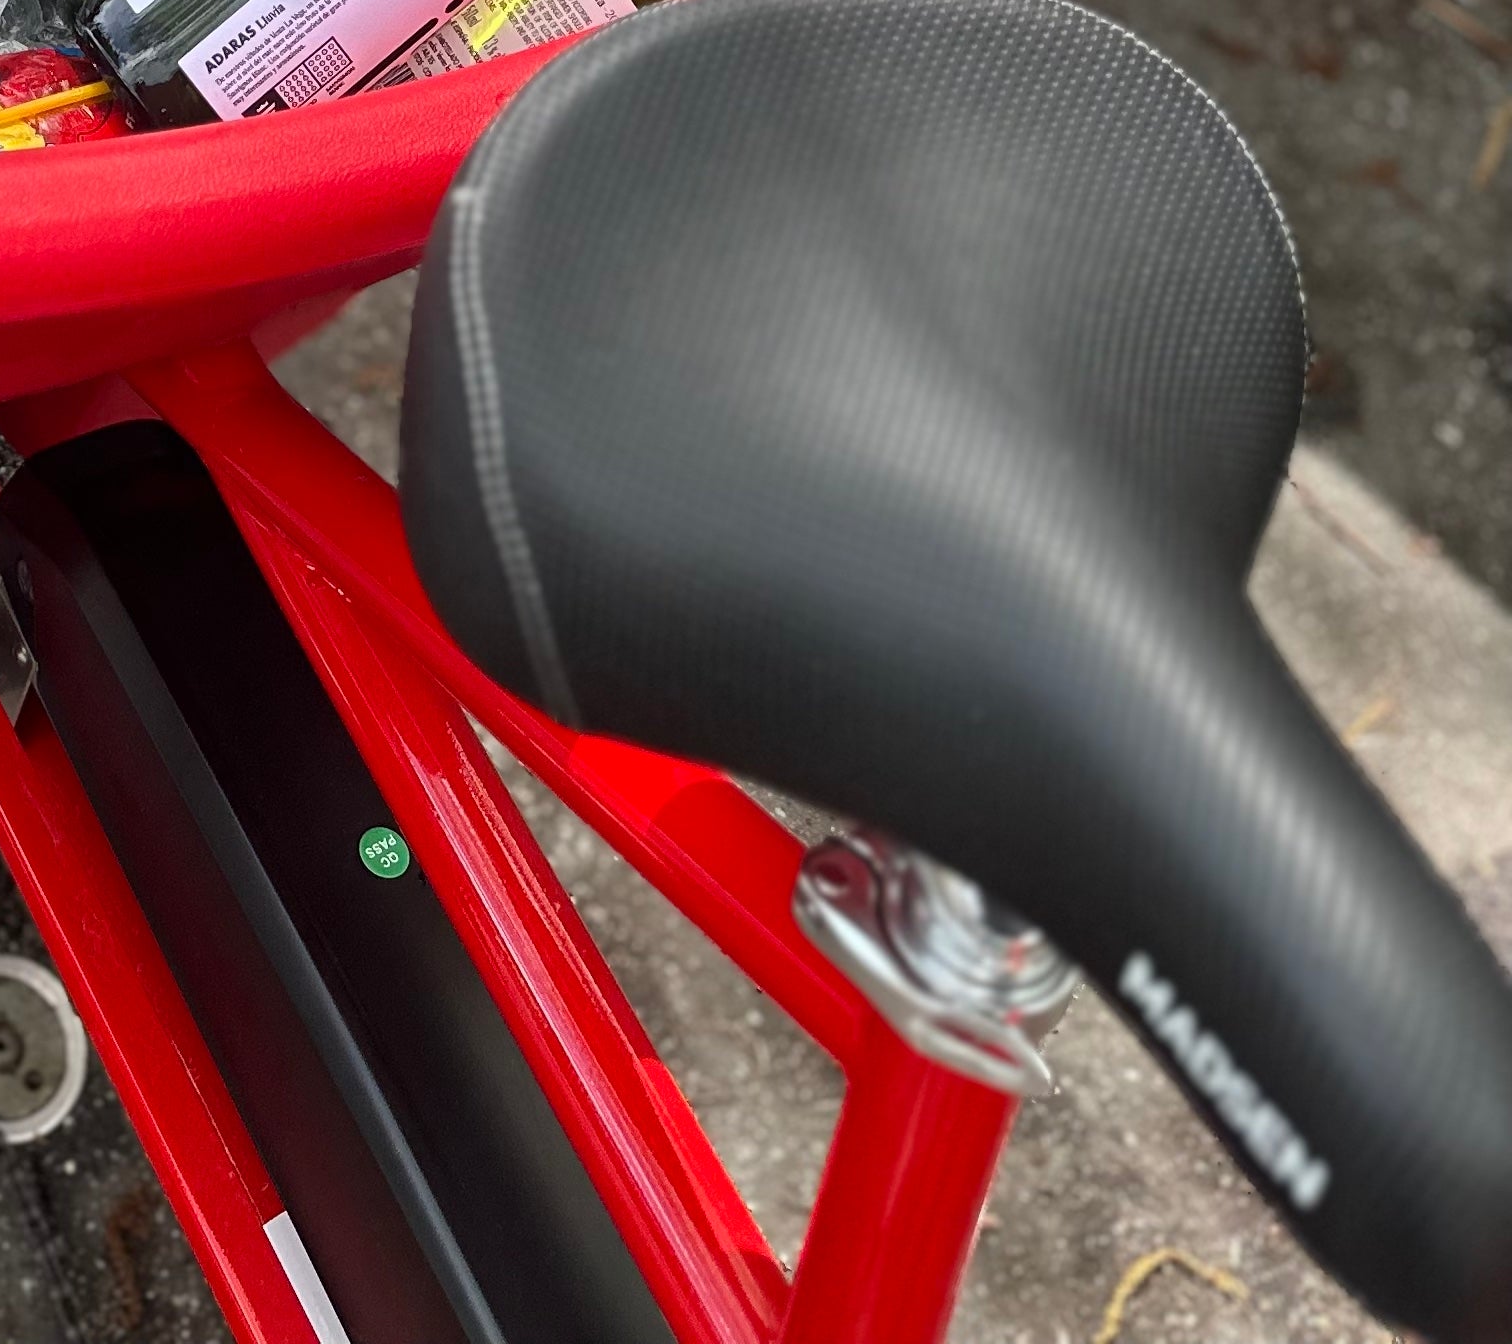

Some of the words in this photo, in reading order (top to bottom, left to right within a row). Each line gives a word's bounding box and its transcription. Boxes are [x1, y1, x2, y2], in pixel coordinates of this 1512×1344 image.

[200, 23, 259, 74] ADARAS
[254, 0, 286, 30] Lluvia
[363, 833, 398, 859] PASS
[378, 850, 400, 868] QC
[1118, 950, 1330, 1210] MADSEN
